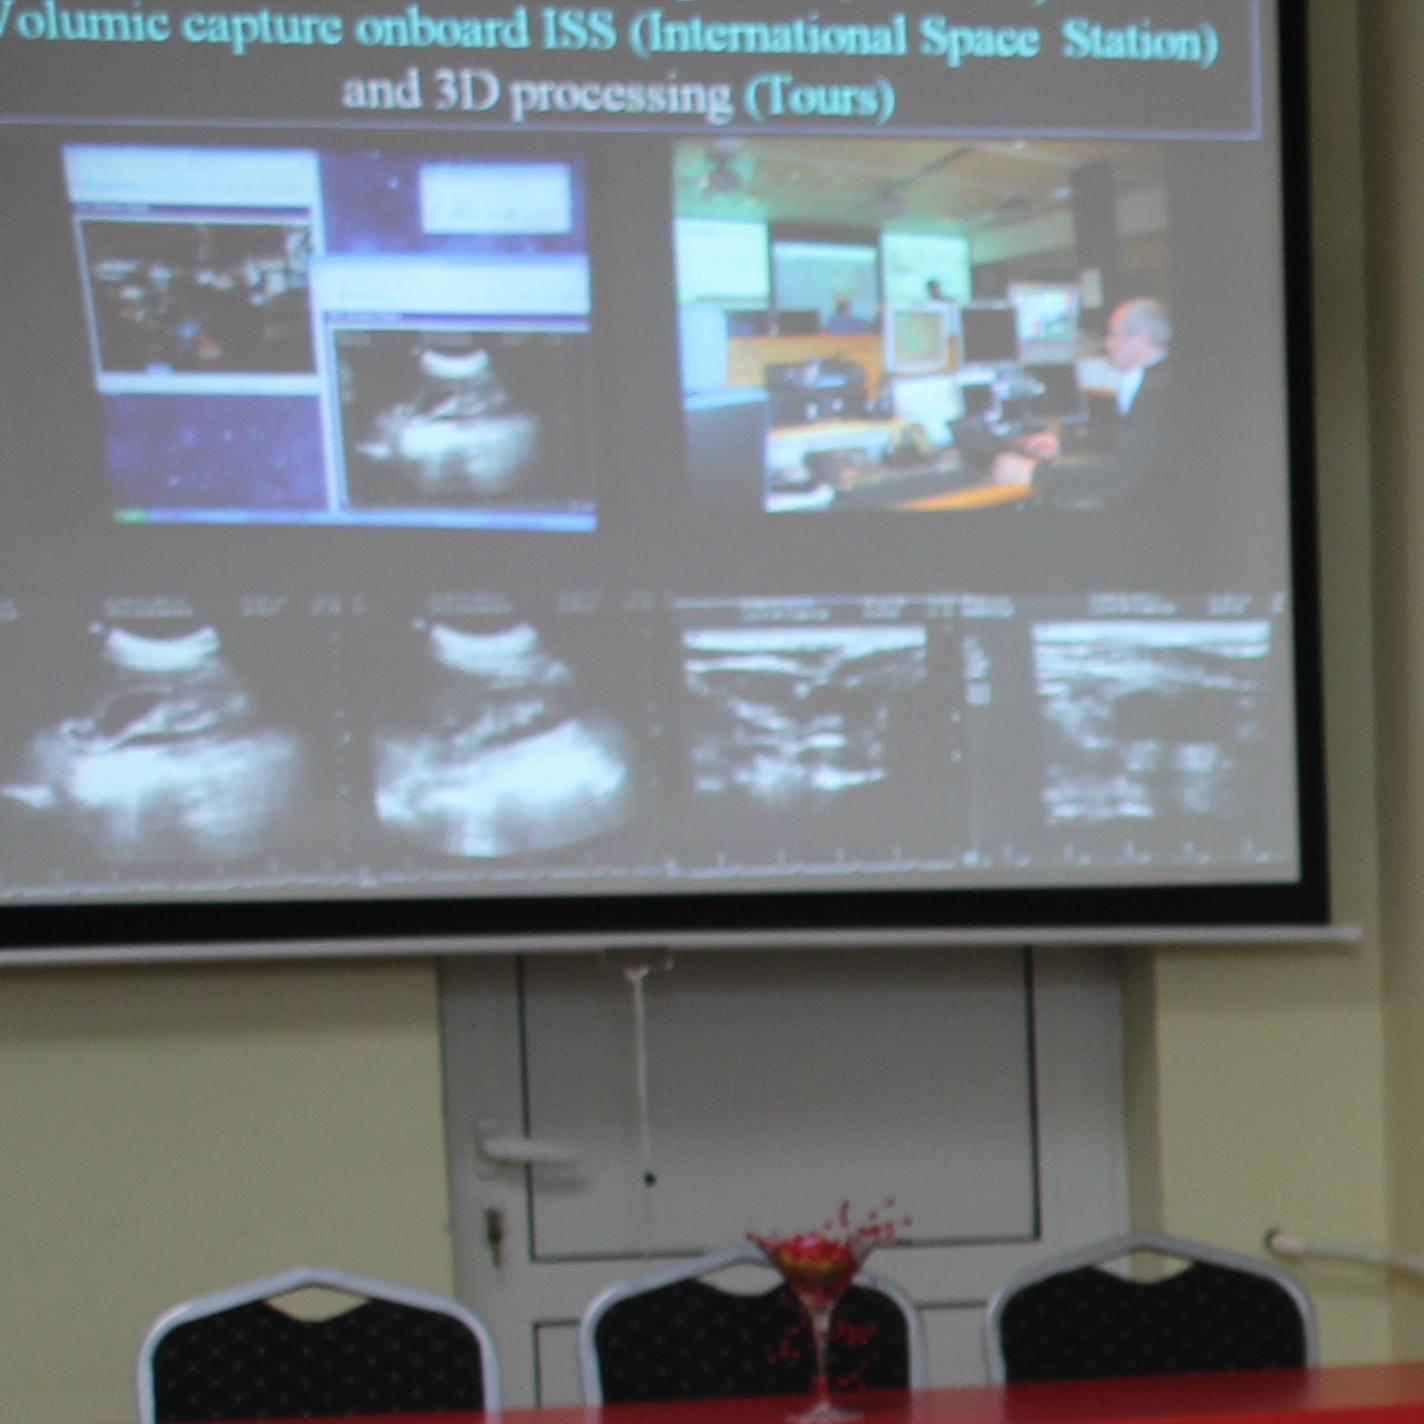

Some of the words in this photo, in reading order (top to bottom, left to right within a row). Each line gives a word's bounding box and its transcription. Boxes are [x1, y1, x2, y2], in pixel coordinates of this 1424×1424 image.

[181, 9, 345, 56] capture
[354, 3, 531, 49] onboard
[540, 8, 618, 51] ISS
[628, 7, 908, 60] (International
[918, 13, 1042, 68] Space
[1060, 15, 1220, 70] Station)
[341, 65, 424, 110] and
[433, 67, 501, 112] 3D
[508, 70, 736, 126] processing
[743, 70, 896, 126] (Tours)
